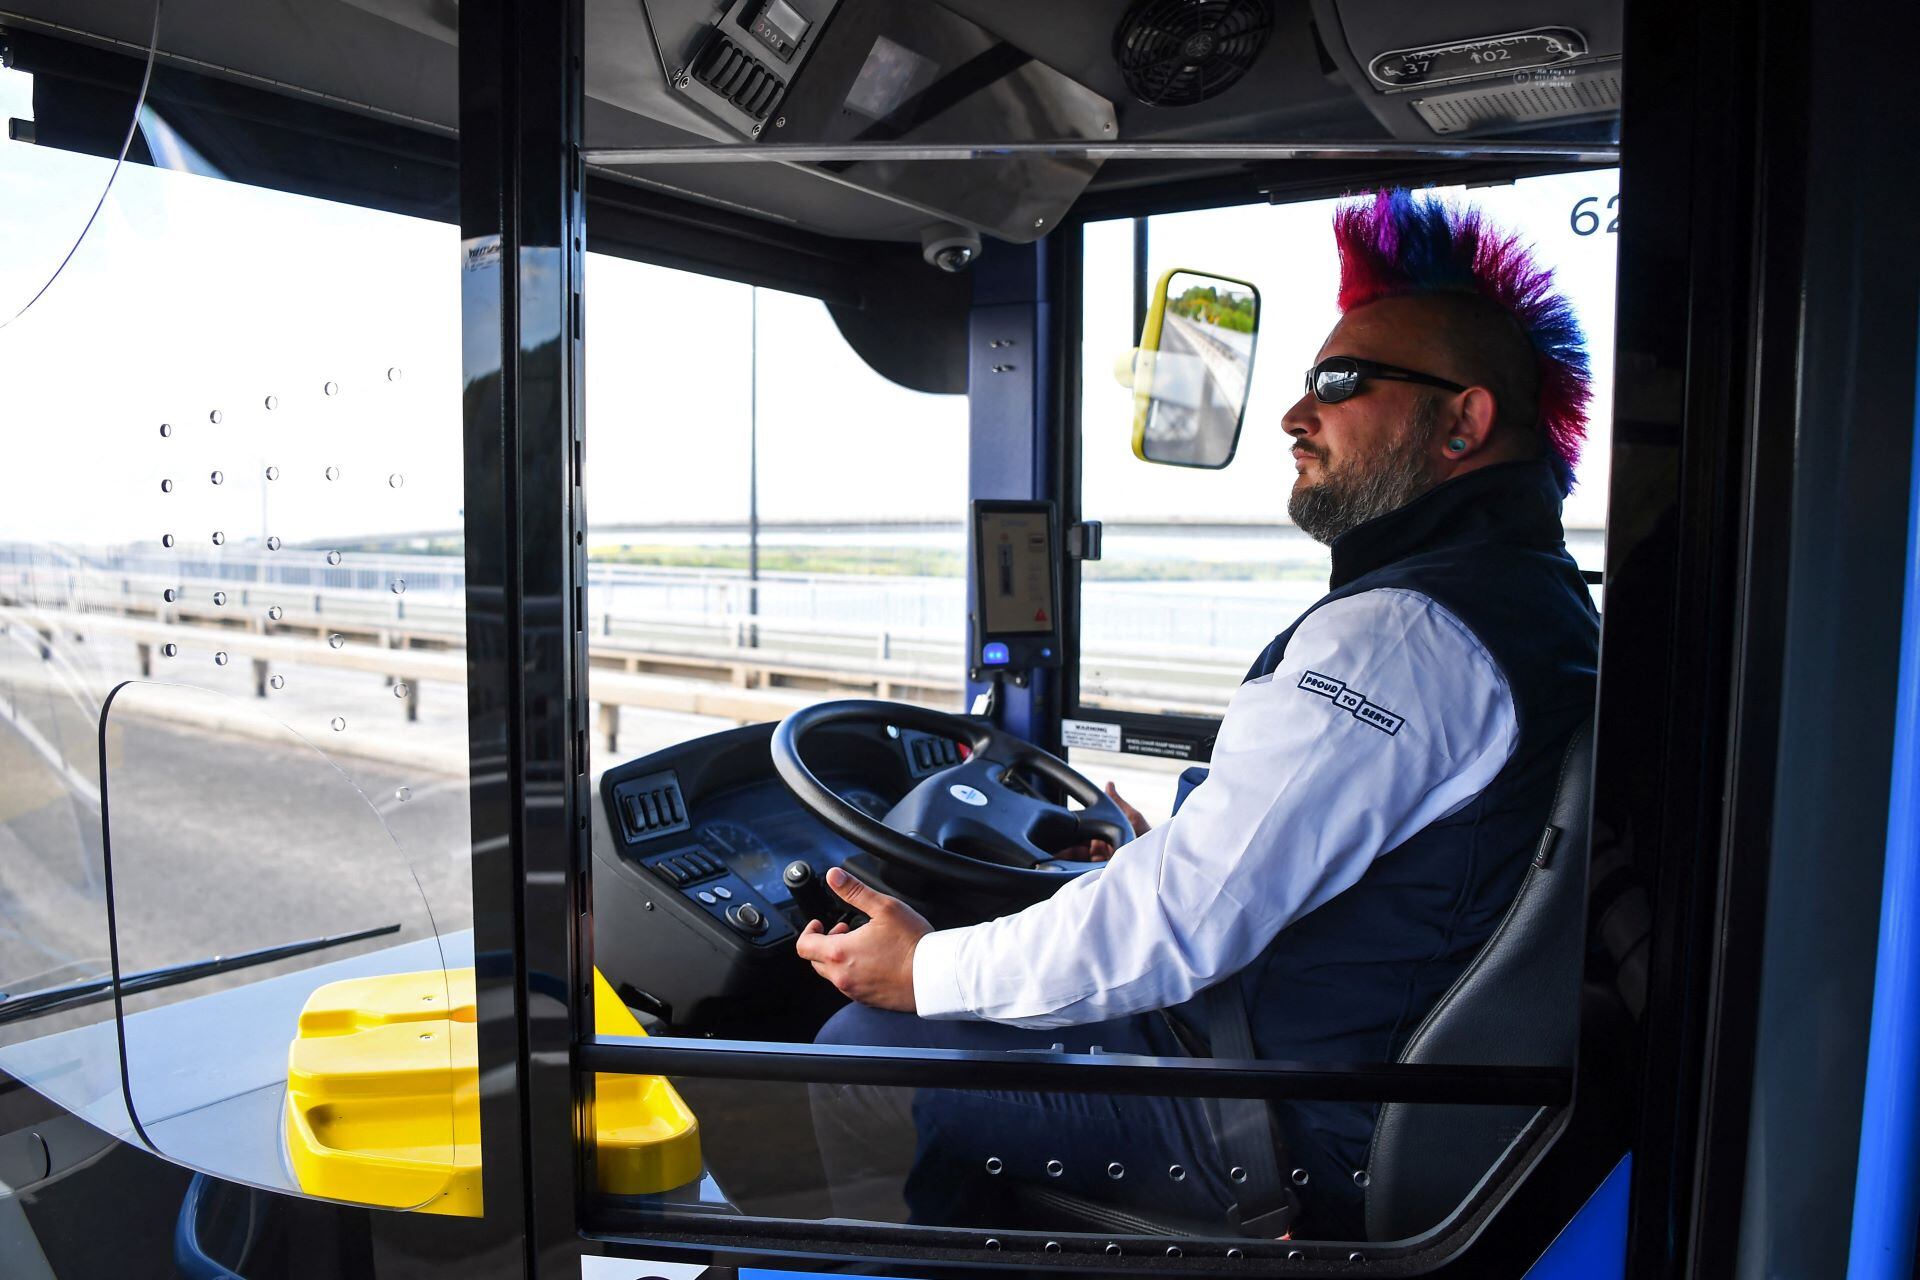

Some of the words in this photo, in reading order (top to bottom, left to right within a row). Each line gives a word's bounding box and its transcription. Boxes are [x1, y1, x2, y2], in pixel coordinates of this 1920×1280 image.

[1405, 61, 1429, 74] 37
[1305, 676, 1338, 693] PROUD
[1342, 694, 1357, 706] TO
[1361, 707, 1395, 728] SERVE
[1075, 724, 1107, 733] WARNING
